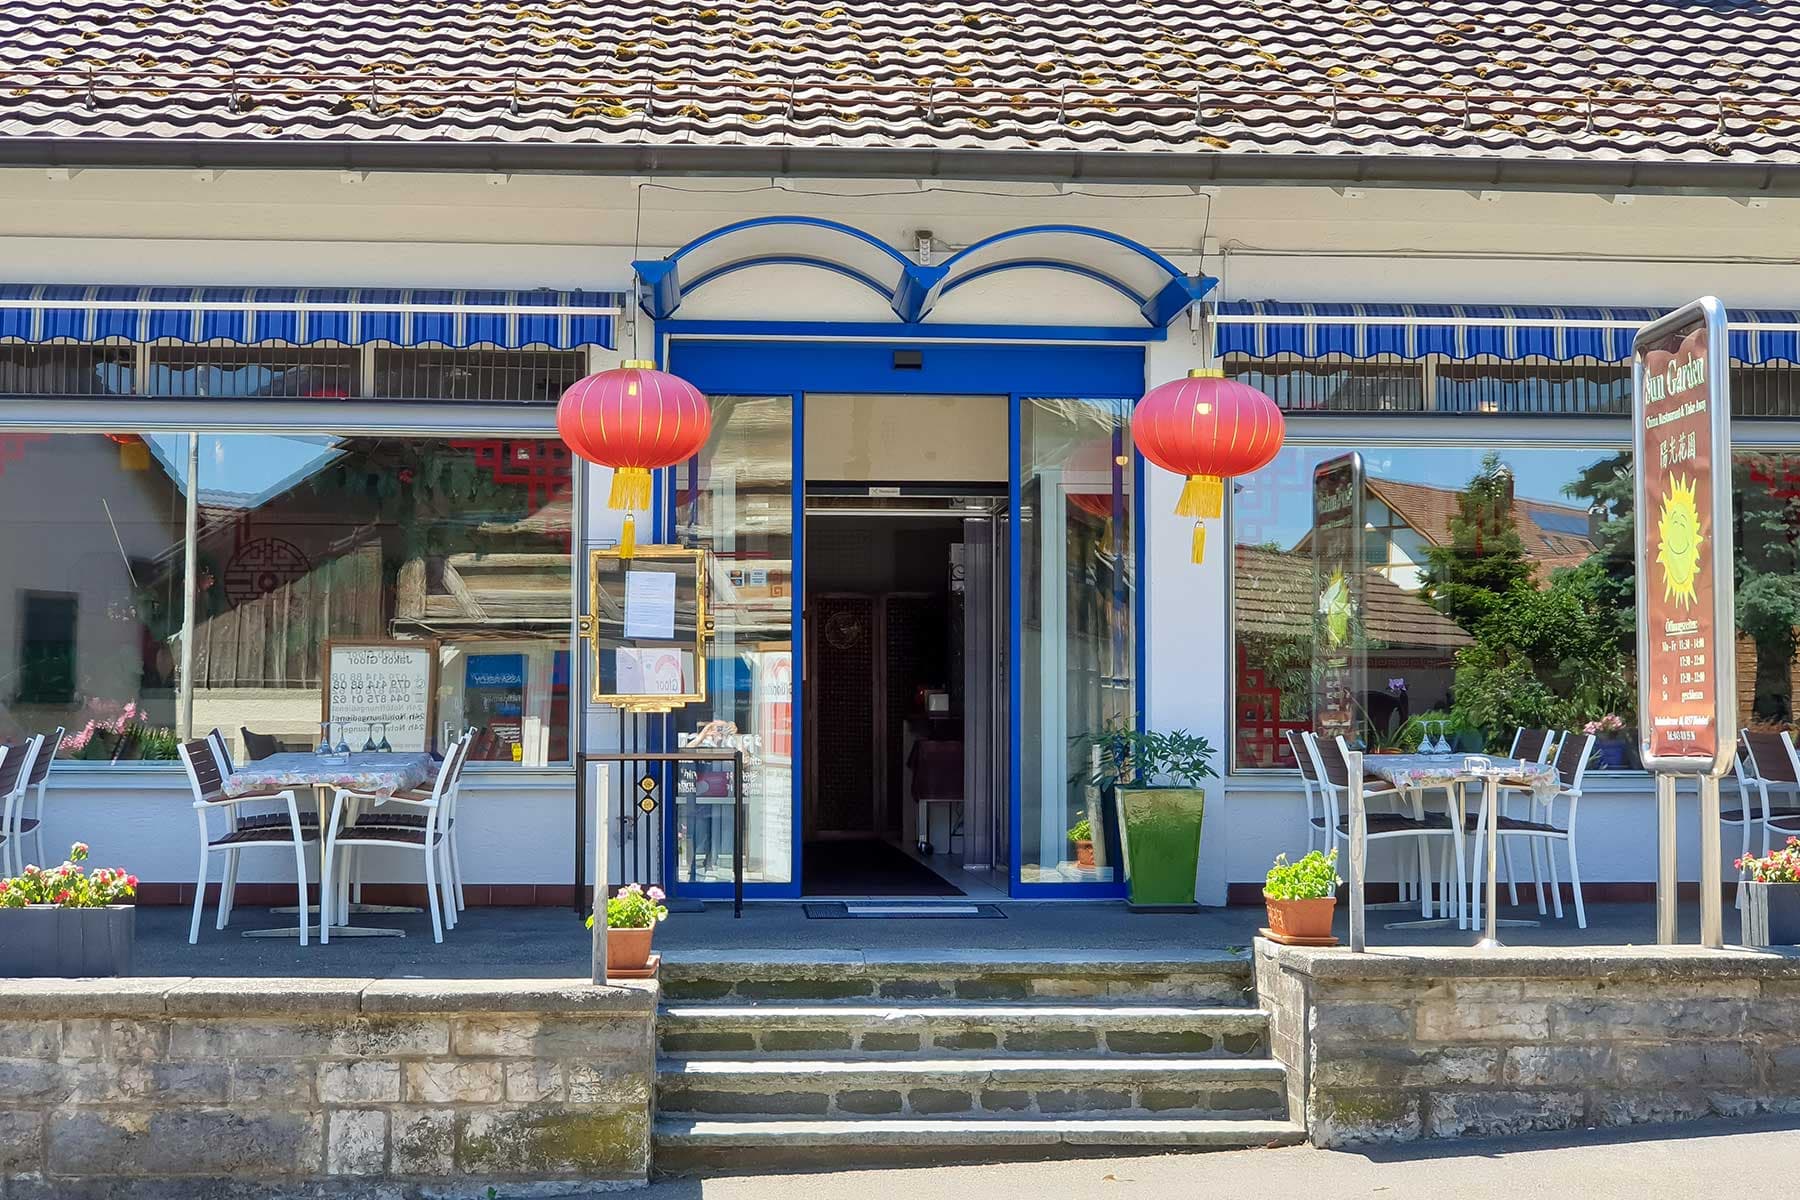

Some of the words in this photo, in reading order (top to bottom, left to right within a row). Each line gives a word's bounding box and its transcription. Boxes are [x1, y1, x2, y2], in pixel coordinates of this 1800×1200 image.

[1645, 367, 1666, 405] Sun
[1667, 352, 1705, 397] Garden
[1660, 432, 1696, 469] 陽光花園
